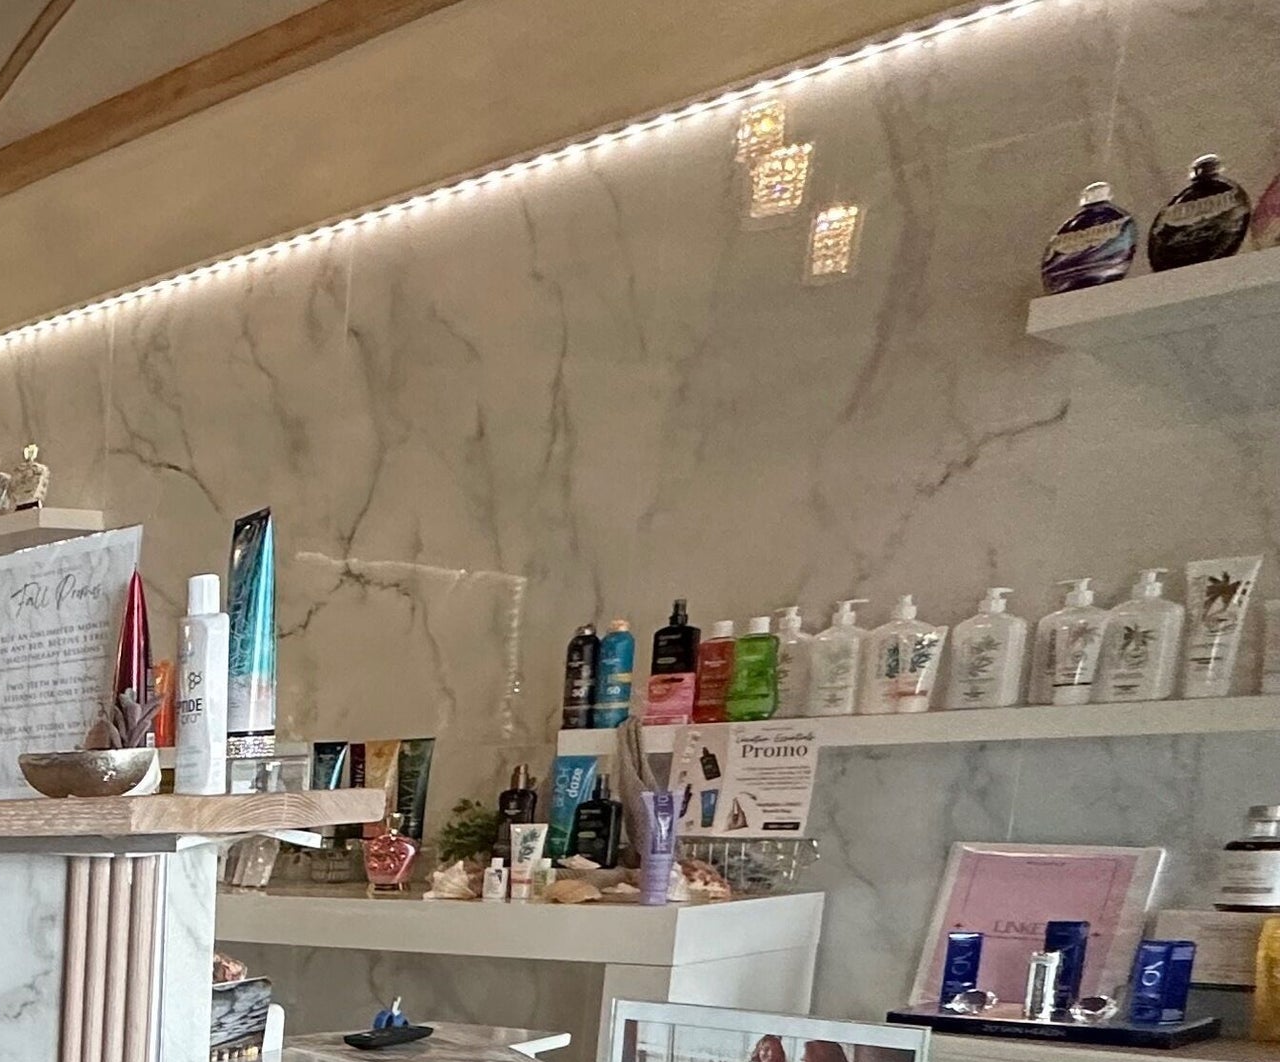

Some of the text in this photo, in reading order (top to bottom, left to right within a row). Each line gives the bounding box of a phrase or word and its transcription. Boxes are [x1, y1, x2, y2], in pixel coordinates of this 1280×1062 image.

[11, 581, 49, 618] Fall
[742, 743, 808, 758] Promo
[565, 768, 583, 798] daze
